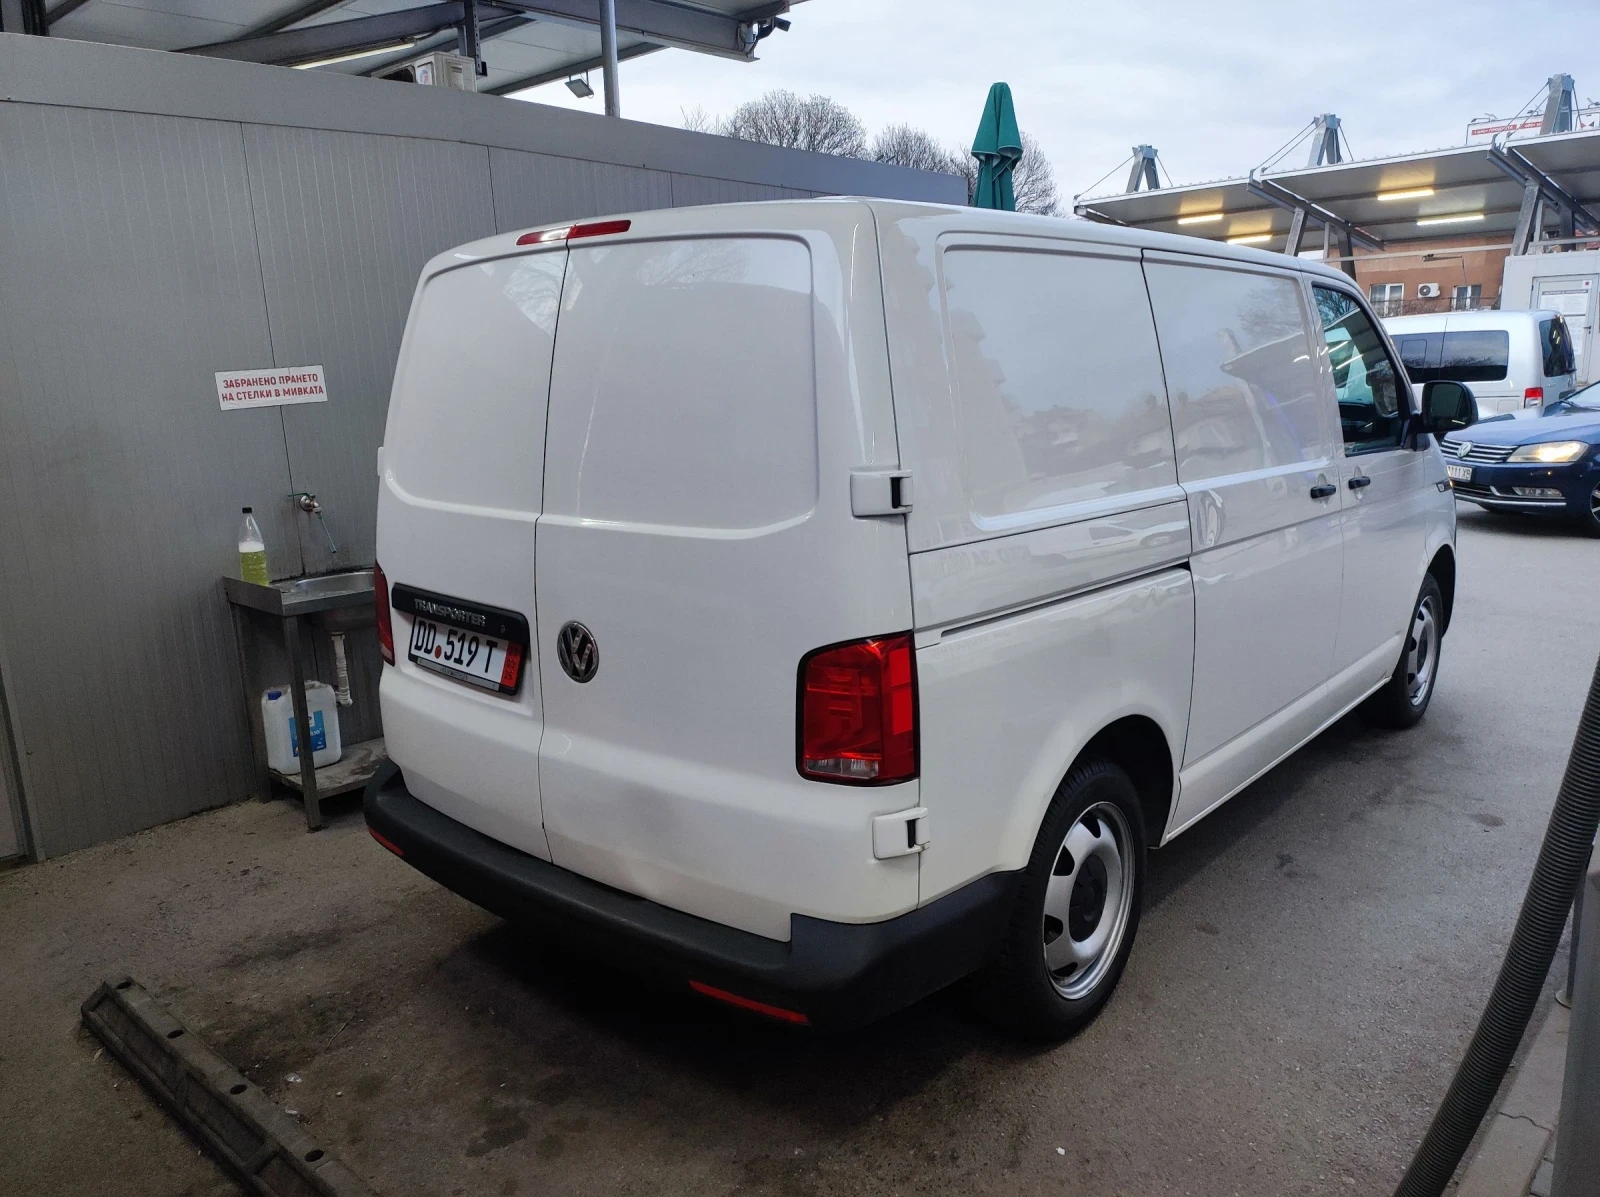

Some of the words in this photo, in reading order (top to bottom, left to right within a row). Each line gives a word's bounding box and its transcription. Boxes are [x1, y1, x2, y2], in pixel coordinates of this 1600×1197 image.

[223, 376, 276, 389] ЗАБРАНЕНО
[279, 373, 318, 385] ПРАНЕТО
[221, 392, 234, 402] НА
[236, 389, 272, 401] СТЕЛКИ
[275, 388, 281, 397] В
[283, 385, 324, 397] МИВКАТА
[414, 598, 486, 627] TRANSPORTER
[414, 620, 437, 654] DD
[443, 629, 480, 667] 519
[484, 640, 498, 673] T
